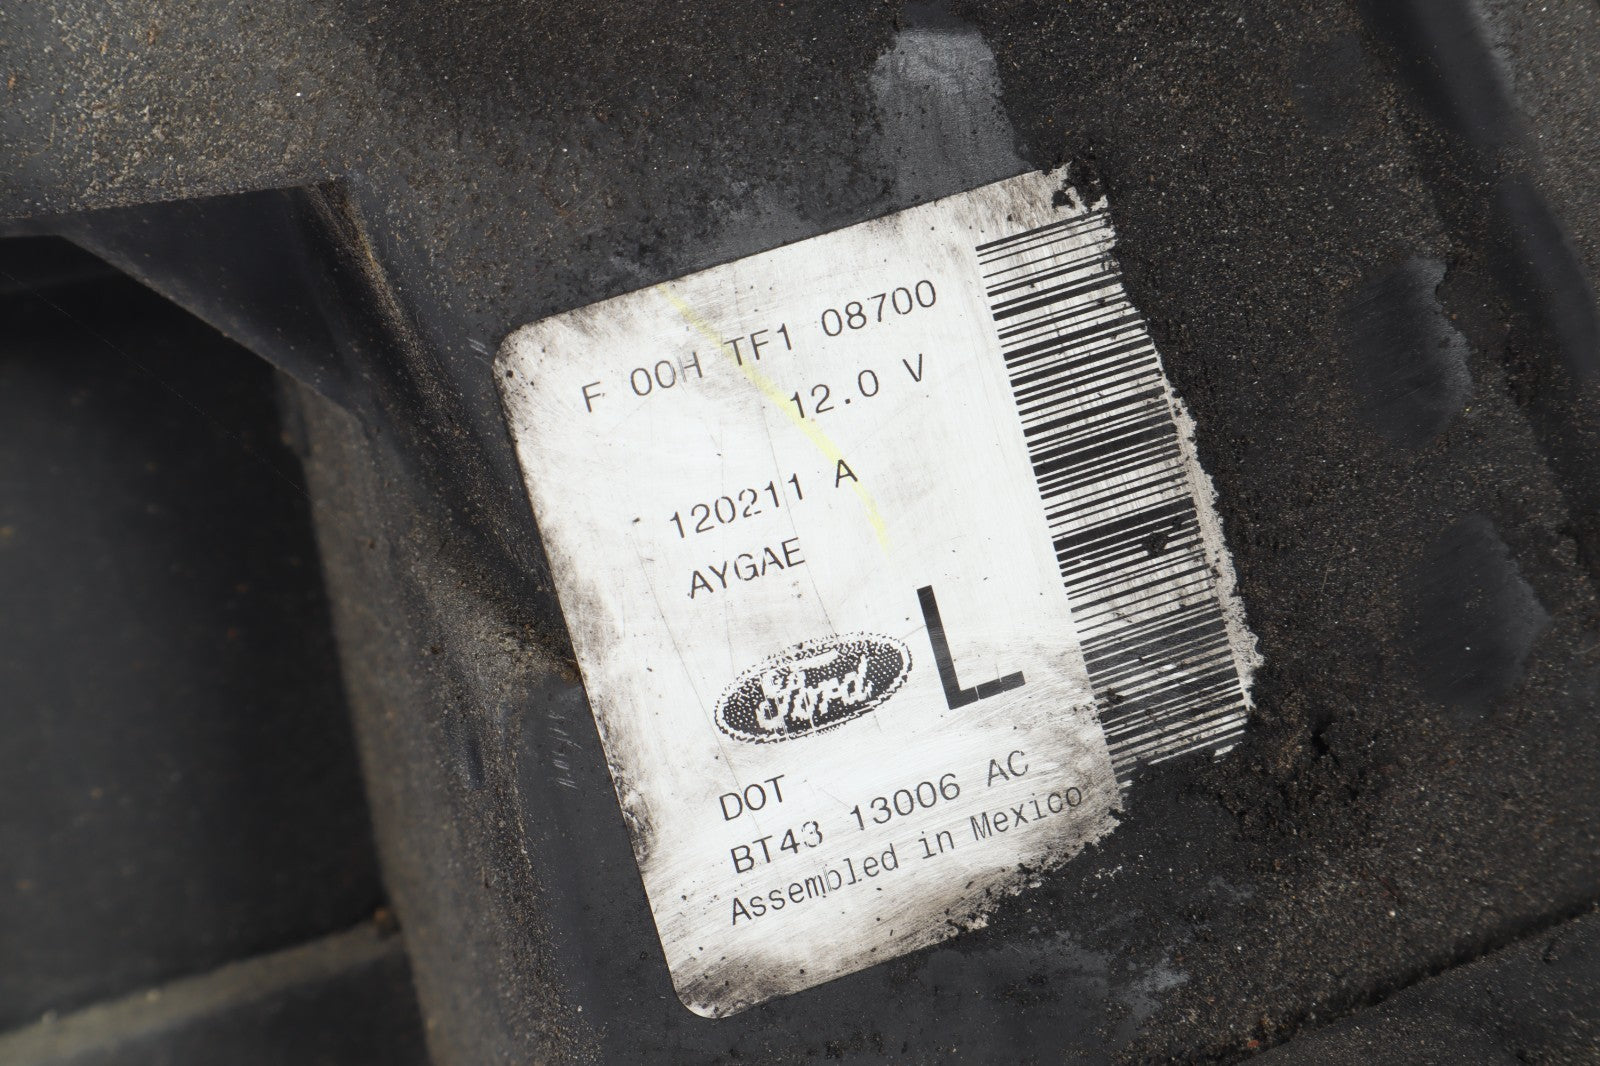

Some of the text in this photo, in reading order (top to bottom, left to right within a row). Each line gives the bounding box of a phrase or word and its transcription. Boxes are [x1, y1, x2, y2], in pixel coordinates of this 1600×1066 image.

[581, 381, 602, 412] F
[723, 323, 792, 366] TF1
[820, 279, 937, 337] 08700
[790, 353, 924, 418] 12.0 V
[669, 459, 858, 539] 120211 A
[689, 537, 806, 599] AYGAE
[916, 585, 1025, 711] L
[719, 775, 786, 821] DOT
[730, 750, 1030, 874] BT43 13006 AC
[731, 785, 1083, 926] Assembled in Mexico
